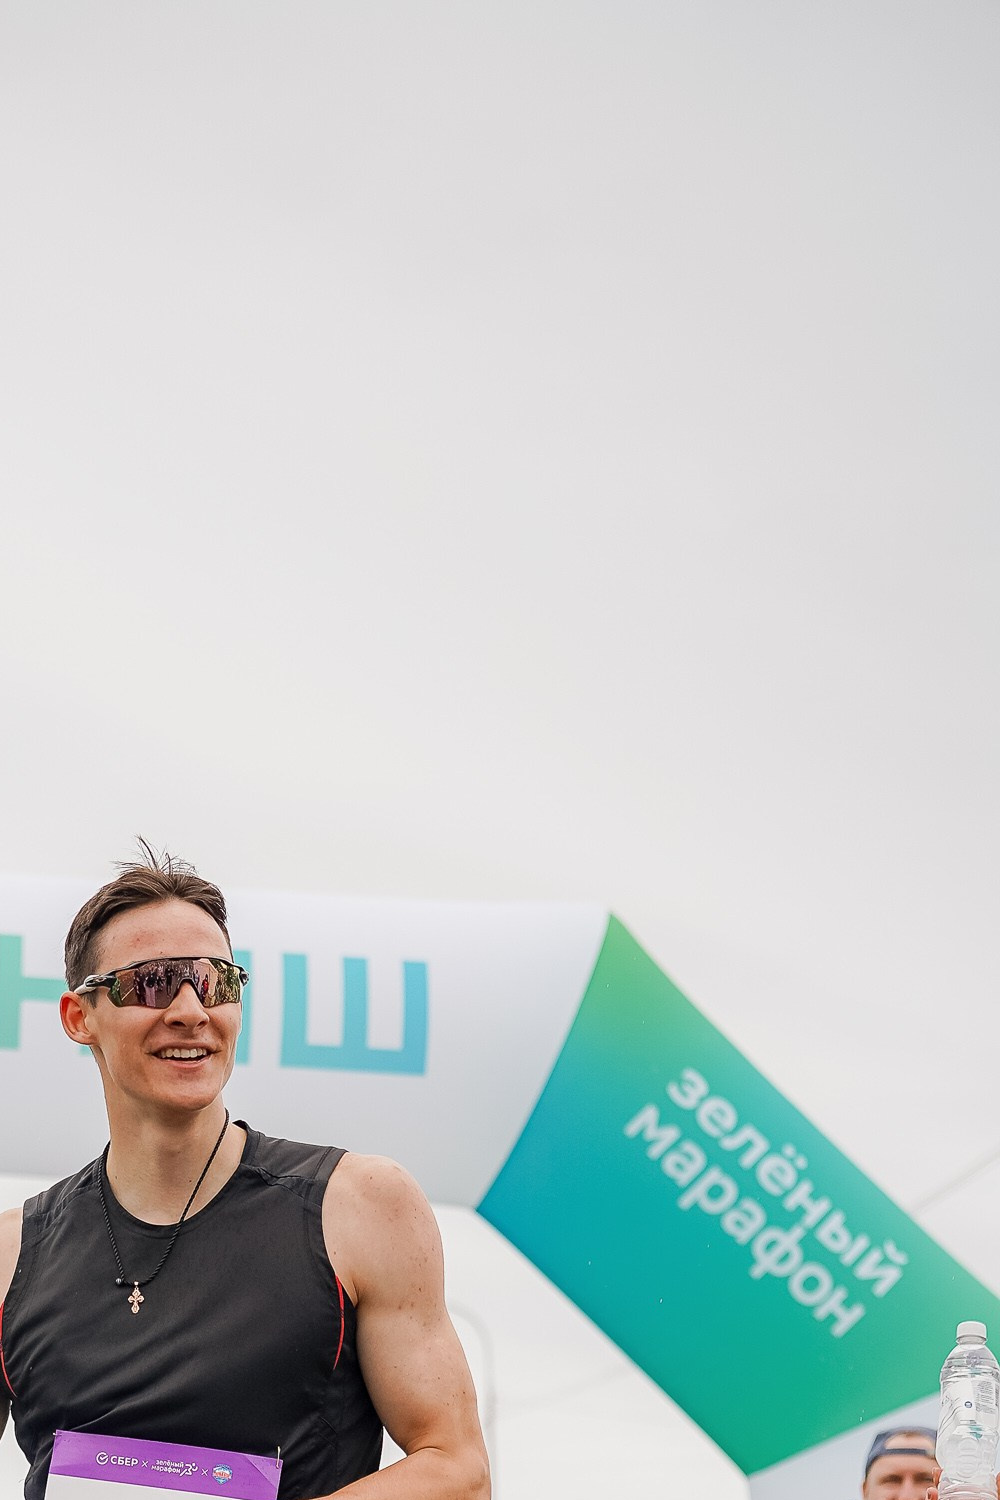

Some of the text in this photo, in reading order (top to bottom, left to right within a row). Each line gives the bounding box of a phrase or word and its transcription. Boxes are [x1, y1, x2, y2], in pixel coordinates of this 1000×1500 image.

[623, 1103, 866, 1338] марафон
[666, 1067, 908, 1298] зелёный
[110, 1456, 139, 1467] СБЕР
